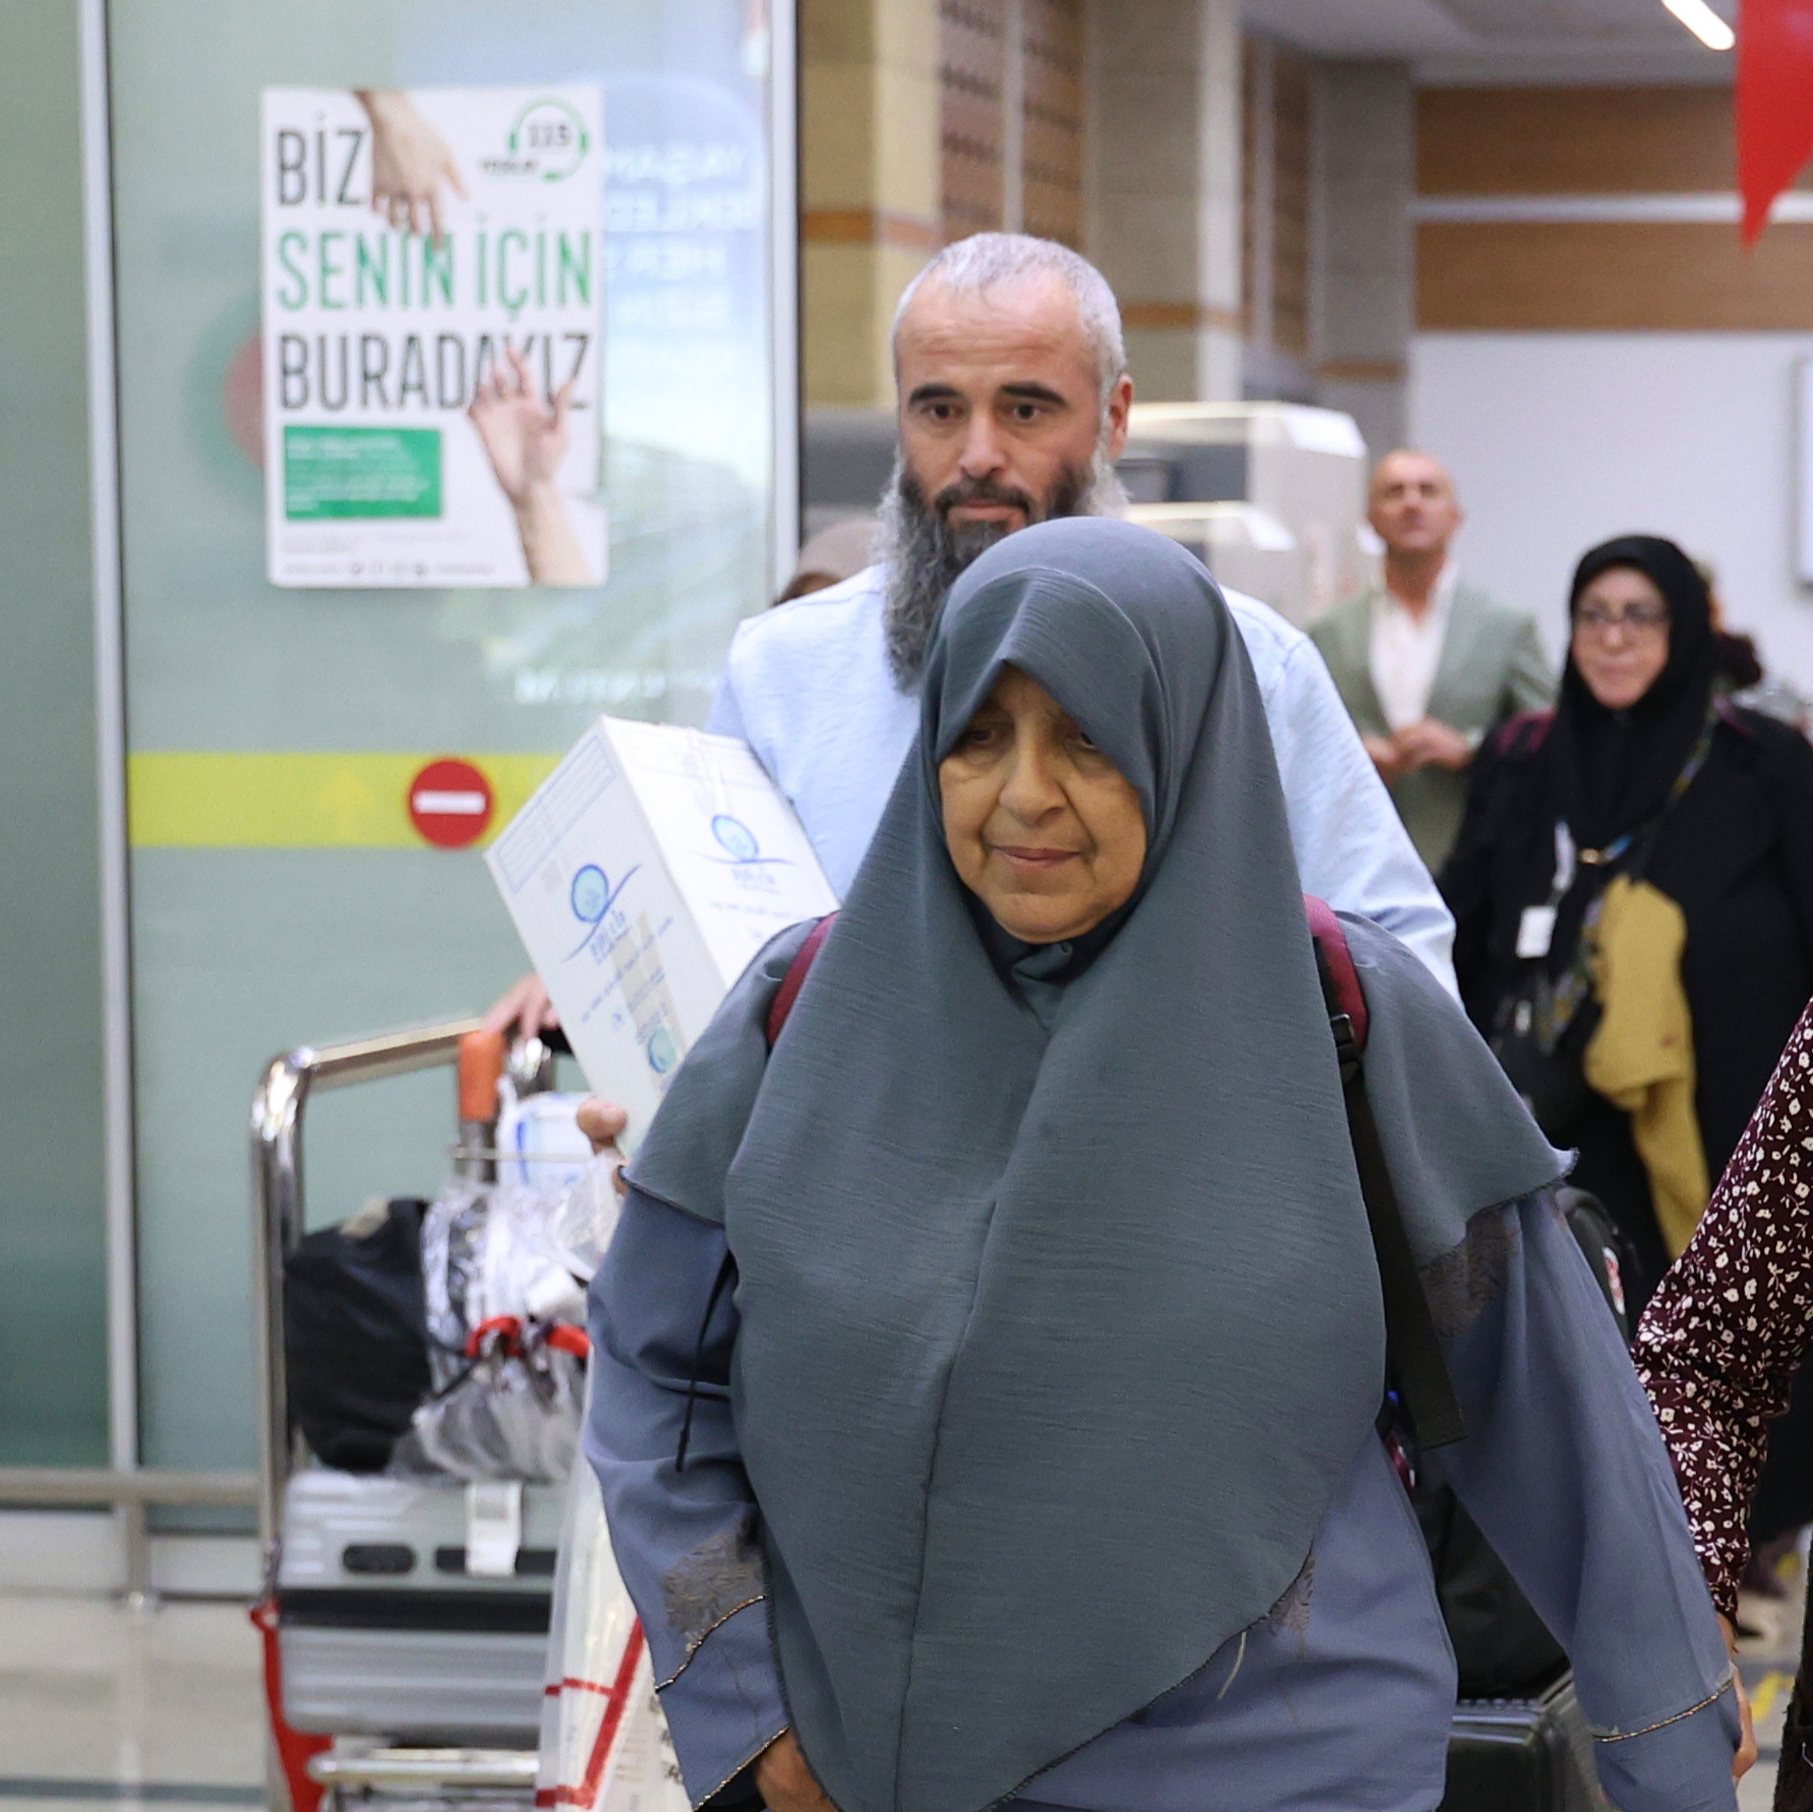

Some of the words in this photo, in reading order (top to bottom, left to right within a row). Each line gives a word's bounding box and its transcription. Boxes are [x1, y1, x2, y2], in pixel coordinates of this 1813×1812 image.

[276, 112, 366, 207] BİZ
[276, 218, 455, 312] SENİN
[476, 212, 593, 321] İÇİN
[279, 332, 592, 411] BURADAYIZ
